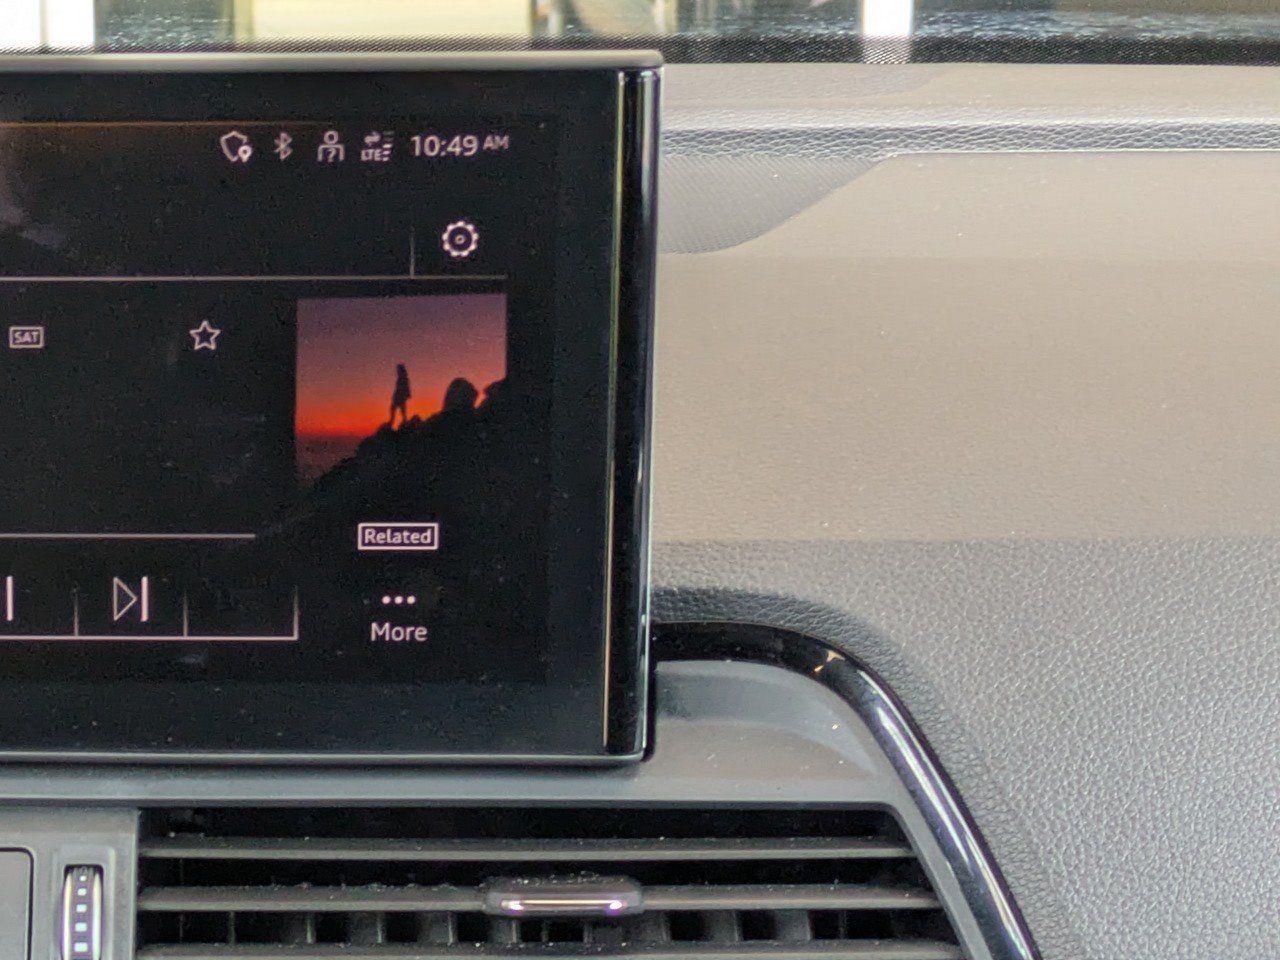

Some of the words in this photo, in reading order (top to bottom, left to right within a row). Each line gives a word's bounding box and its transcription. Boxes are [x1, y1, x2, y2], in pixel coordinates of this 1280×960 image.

[410, 135, 479, 156] 10:49
[482, 134, 511, 150] AM
[14, 331, 39, 343] SAT
[364, 528, 433, 544] Related
[370, 622, 429, 642] More
